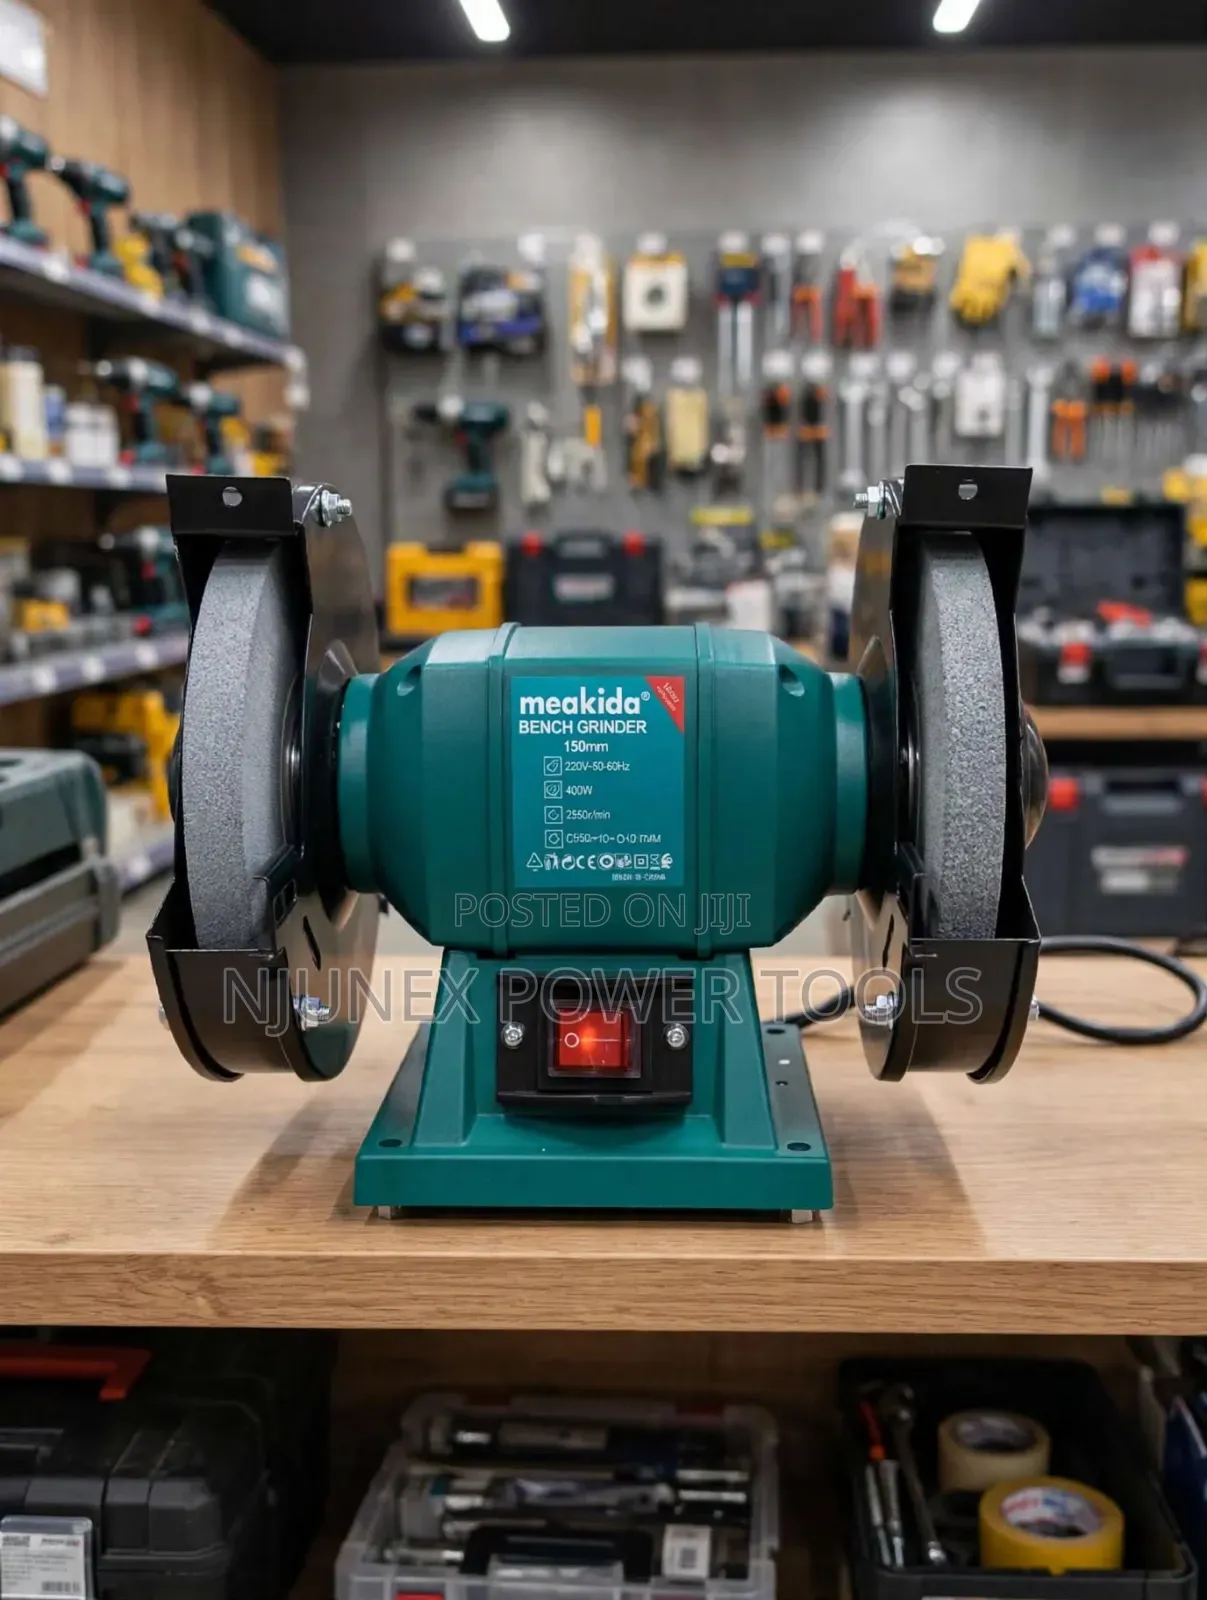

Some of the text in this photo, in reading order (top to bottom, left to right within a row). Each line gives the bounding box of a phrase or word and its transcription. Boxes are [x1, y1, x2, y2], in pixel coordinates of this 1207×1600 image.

[519, 719, 648, 735] BENCH GRINDER
[563, 740, 609, 753] 150mm
[565, 784, 593, 797] 400W
